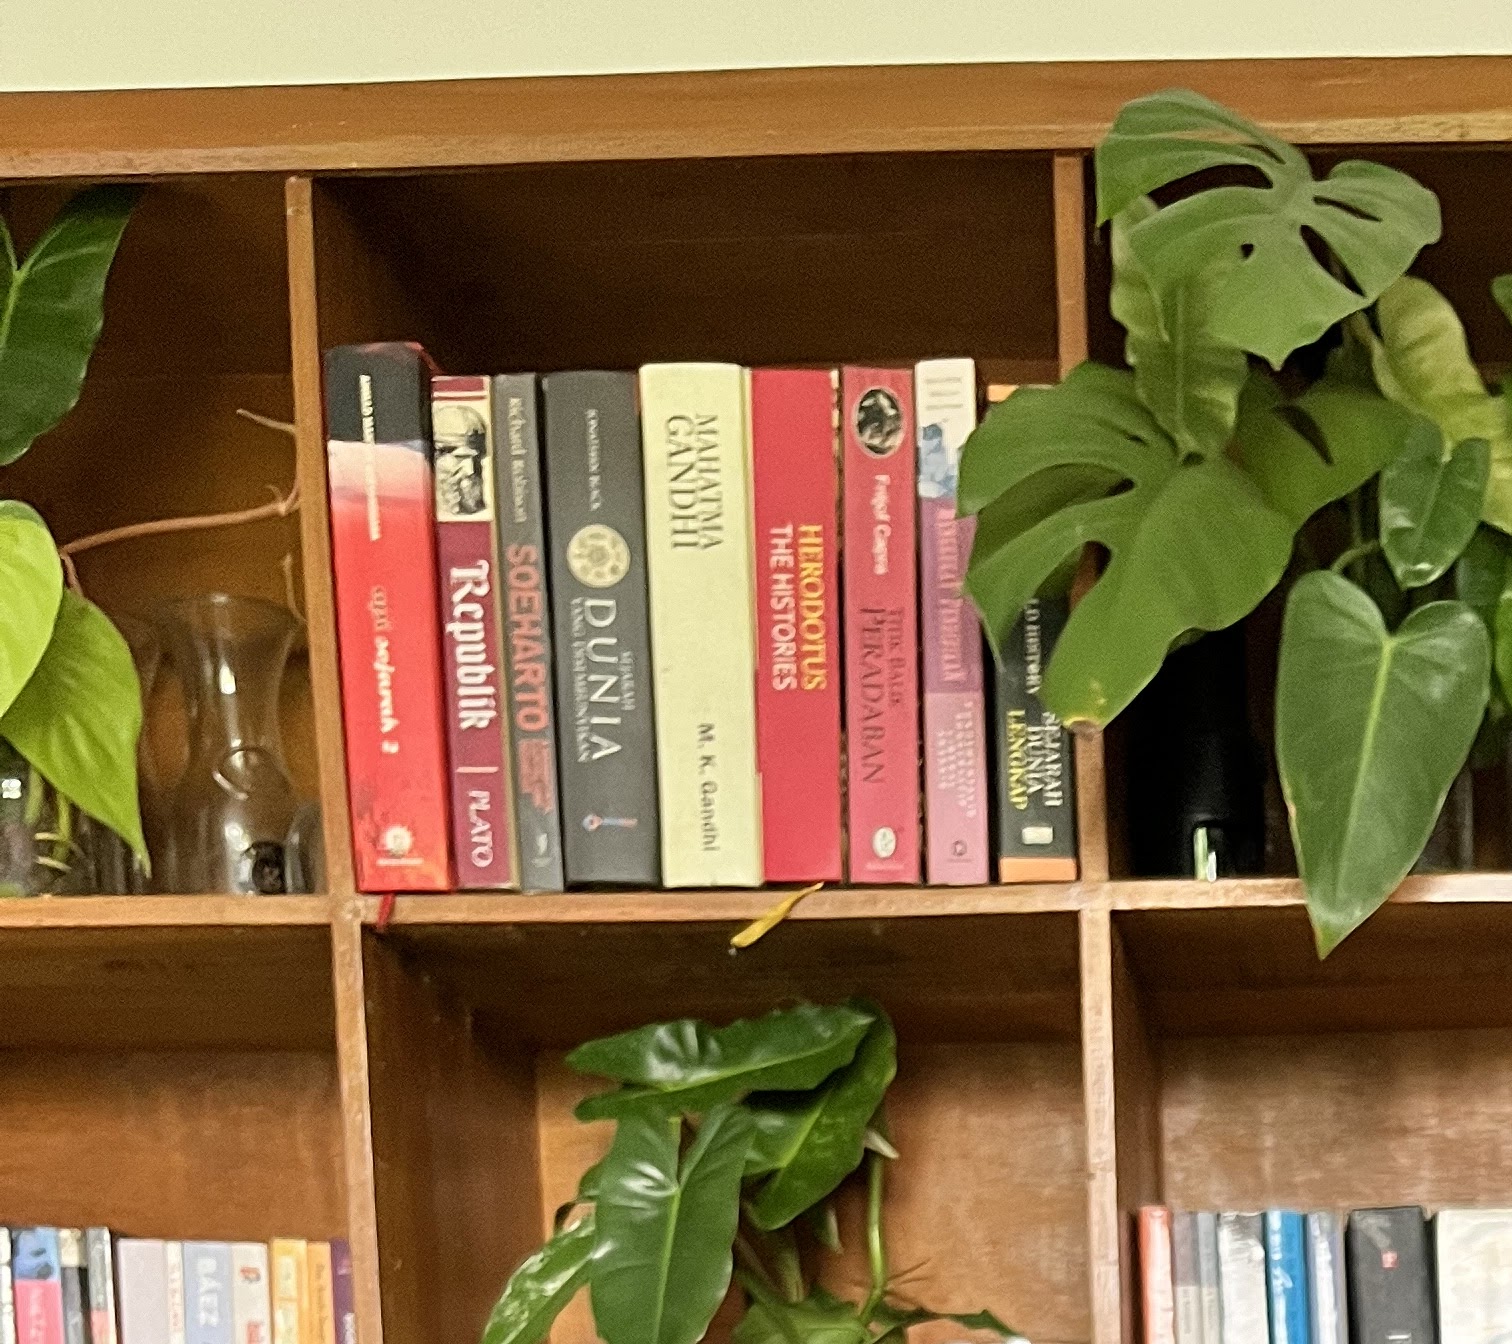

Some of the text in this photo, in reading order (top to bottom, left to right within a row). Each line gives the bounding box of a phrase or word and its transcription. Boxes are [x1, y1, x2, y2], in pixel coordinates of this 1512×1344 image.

[665, 414, 699, 550] GANDHI
[695, 413, 724, 551] MAHATMA
[446, 560, 497, 730] Republik
[505, 543, 548, 732] SOEHARTO
[584, 598, 622, 761] DUNIA
[769, 524, 798, 692] THE HISTORIES
[799, 524, 827, 691] HERODOTUS
[859, 606, 889, 783] PERADABAN
[1027, 725, 1046, 794] DUNIA
[468, 788, 493, 867] PLATO
[699, 780, 722, 853] Gandhi
